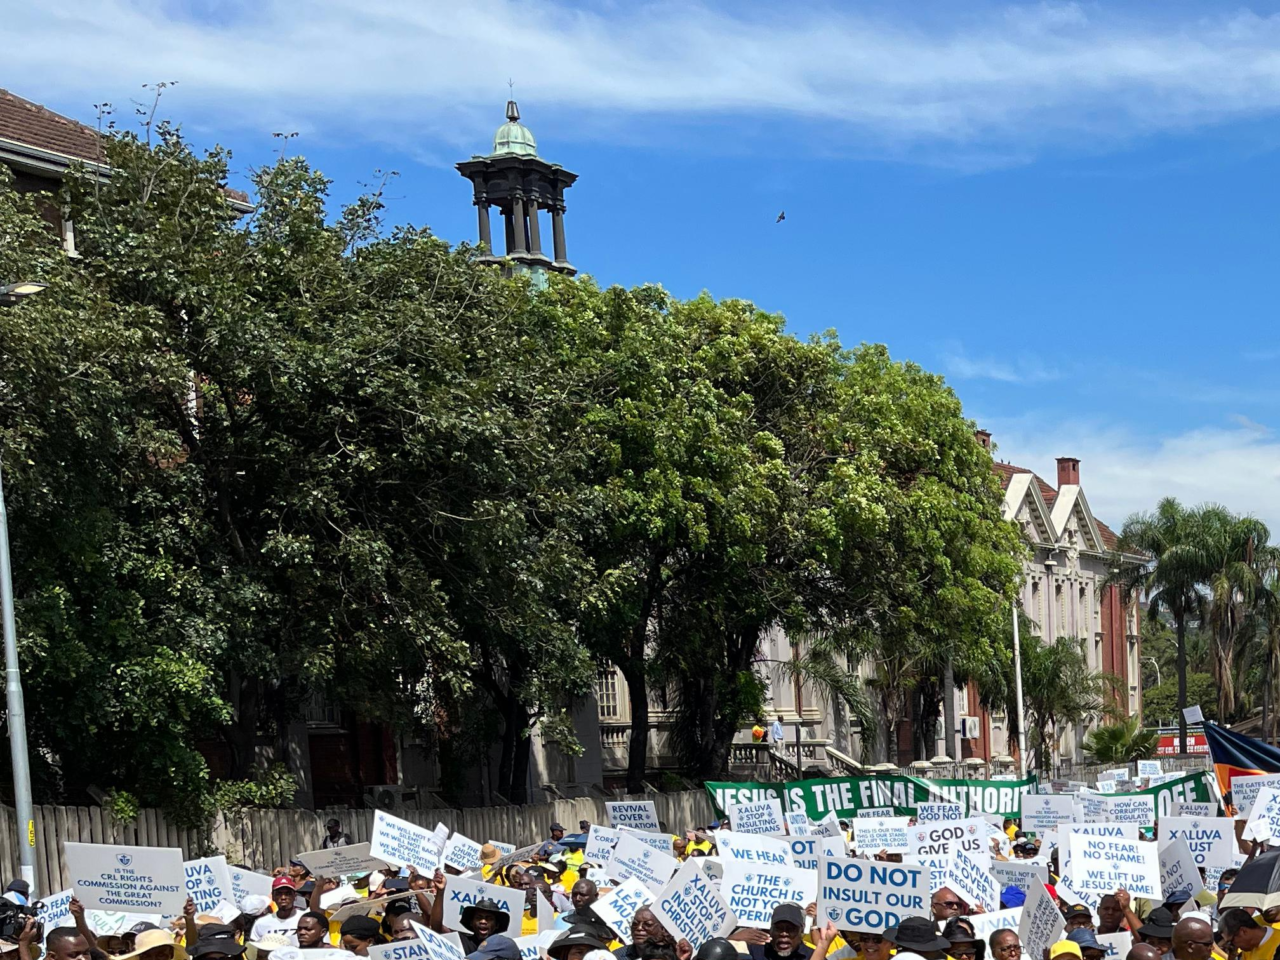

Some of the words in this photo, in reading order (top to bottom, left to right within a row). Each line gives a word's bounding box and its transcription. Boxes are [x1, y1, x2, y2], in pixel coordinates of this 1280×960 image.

[783, 787, 806, 813] IS
[812, 783, 854, 812] THE
[859, 780, 918, 808] FINAL
[738, 804, 772, 814] XALUVA
[746, 812, 765, 820] STOP
[1109, 807, 1153, 815] CORRUPTION
[385, 822, 396, 830] WE
[397, 825, 412, 835] WILL
[737, 818, 776, 829] INSULTING
[379, 830, 390, 838] WE
[391, 834, 406, 844] WILL
[407, 839, 420, 848] NOT
[399, 832, 421, 844] SILENT!
[929, 827, 964, 842] GOD
[397, 843, 420, 855] DOWN!
[467, 845, 479, 854] THE
[918, 843, 949, 855] GIVE
[961, 839, 980, 851] US
[1088, 840, 1105, 850] NO
[1108, 843, 1139, 854] FEAR!
[379, 842, 390, 850] WE
[390, 845, 405, 855] WILL
[406, 850, 437, 867] CONTEND
[383, 849, 397, 859] FOR
[397, 854, 412, 864] OUR
[413, 859, 433, 872] FAITH!
[451, 851, 467, 862] NOT
[731, 848, 752, 860] WE
[756, 851, 787, 866] HEAR
[1083, 851, 1101, 860] NO
[1104, 854, 1146, 864] SHAME!
[827, 862, 863, 882] DO
[870, 866, 922, 888] NOT
[957, 850, 995, 892] REVIVAL
[1167, 860, 1183, 876] NOT
[101, 873, 118, 882] CRL
[120, 874, 153, 884] RIGHTS
[757, 874, 781, 886] THE
[961, 868, 988, 897] OVER
[1087, 870, 1105, 880] WE
[1108, 872, 1128, 882] LIFT
[1131, 874, 1145, 883] UP
[77, 879, 137, 891] COMMISSION
[140, 883, 180, 893] AGAINST
[732, 884, 788, 900] CHURCH
[792, 890, 804, 901] IS
[948, 870, 995, 913] REGULATIO
[1080, 880, 1116, 890] JESUS'
[1120, 883, 1154, 894] NAME!
[122, 891, 152, 899] GREAT
[690, 873, 726, 923] XALUVA
[730, 896, 760, 907] NOT
[823, 886, 882, 905] INSULT
[886, 893, 924, 910] OUR
[99, 897, 162, 908] COMMISSION?
[690, 895, 713, 921] STOP
[845, 907, 900, 929] GOD
[393, 944, 429, 960] STAN
